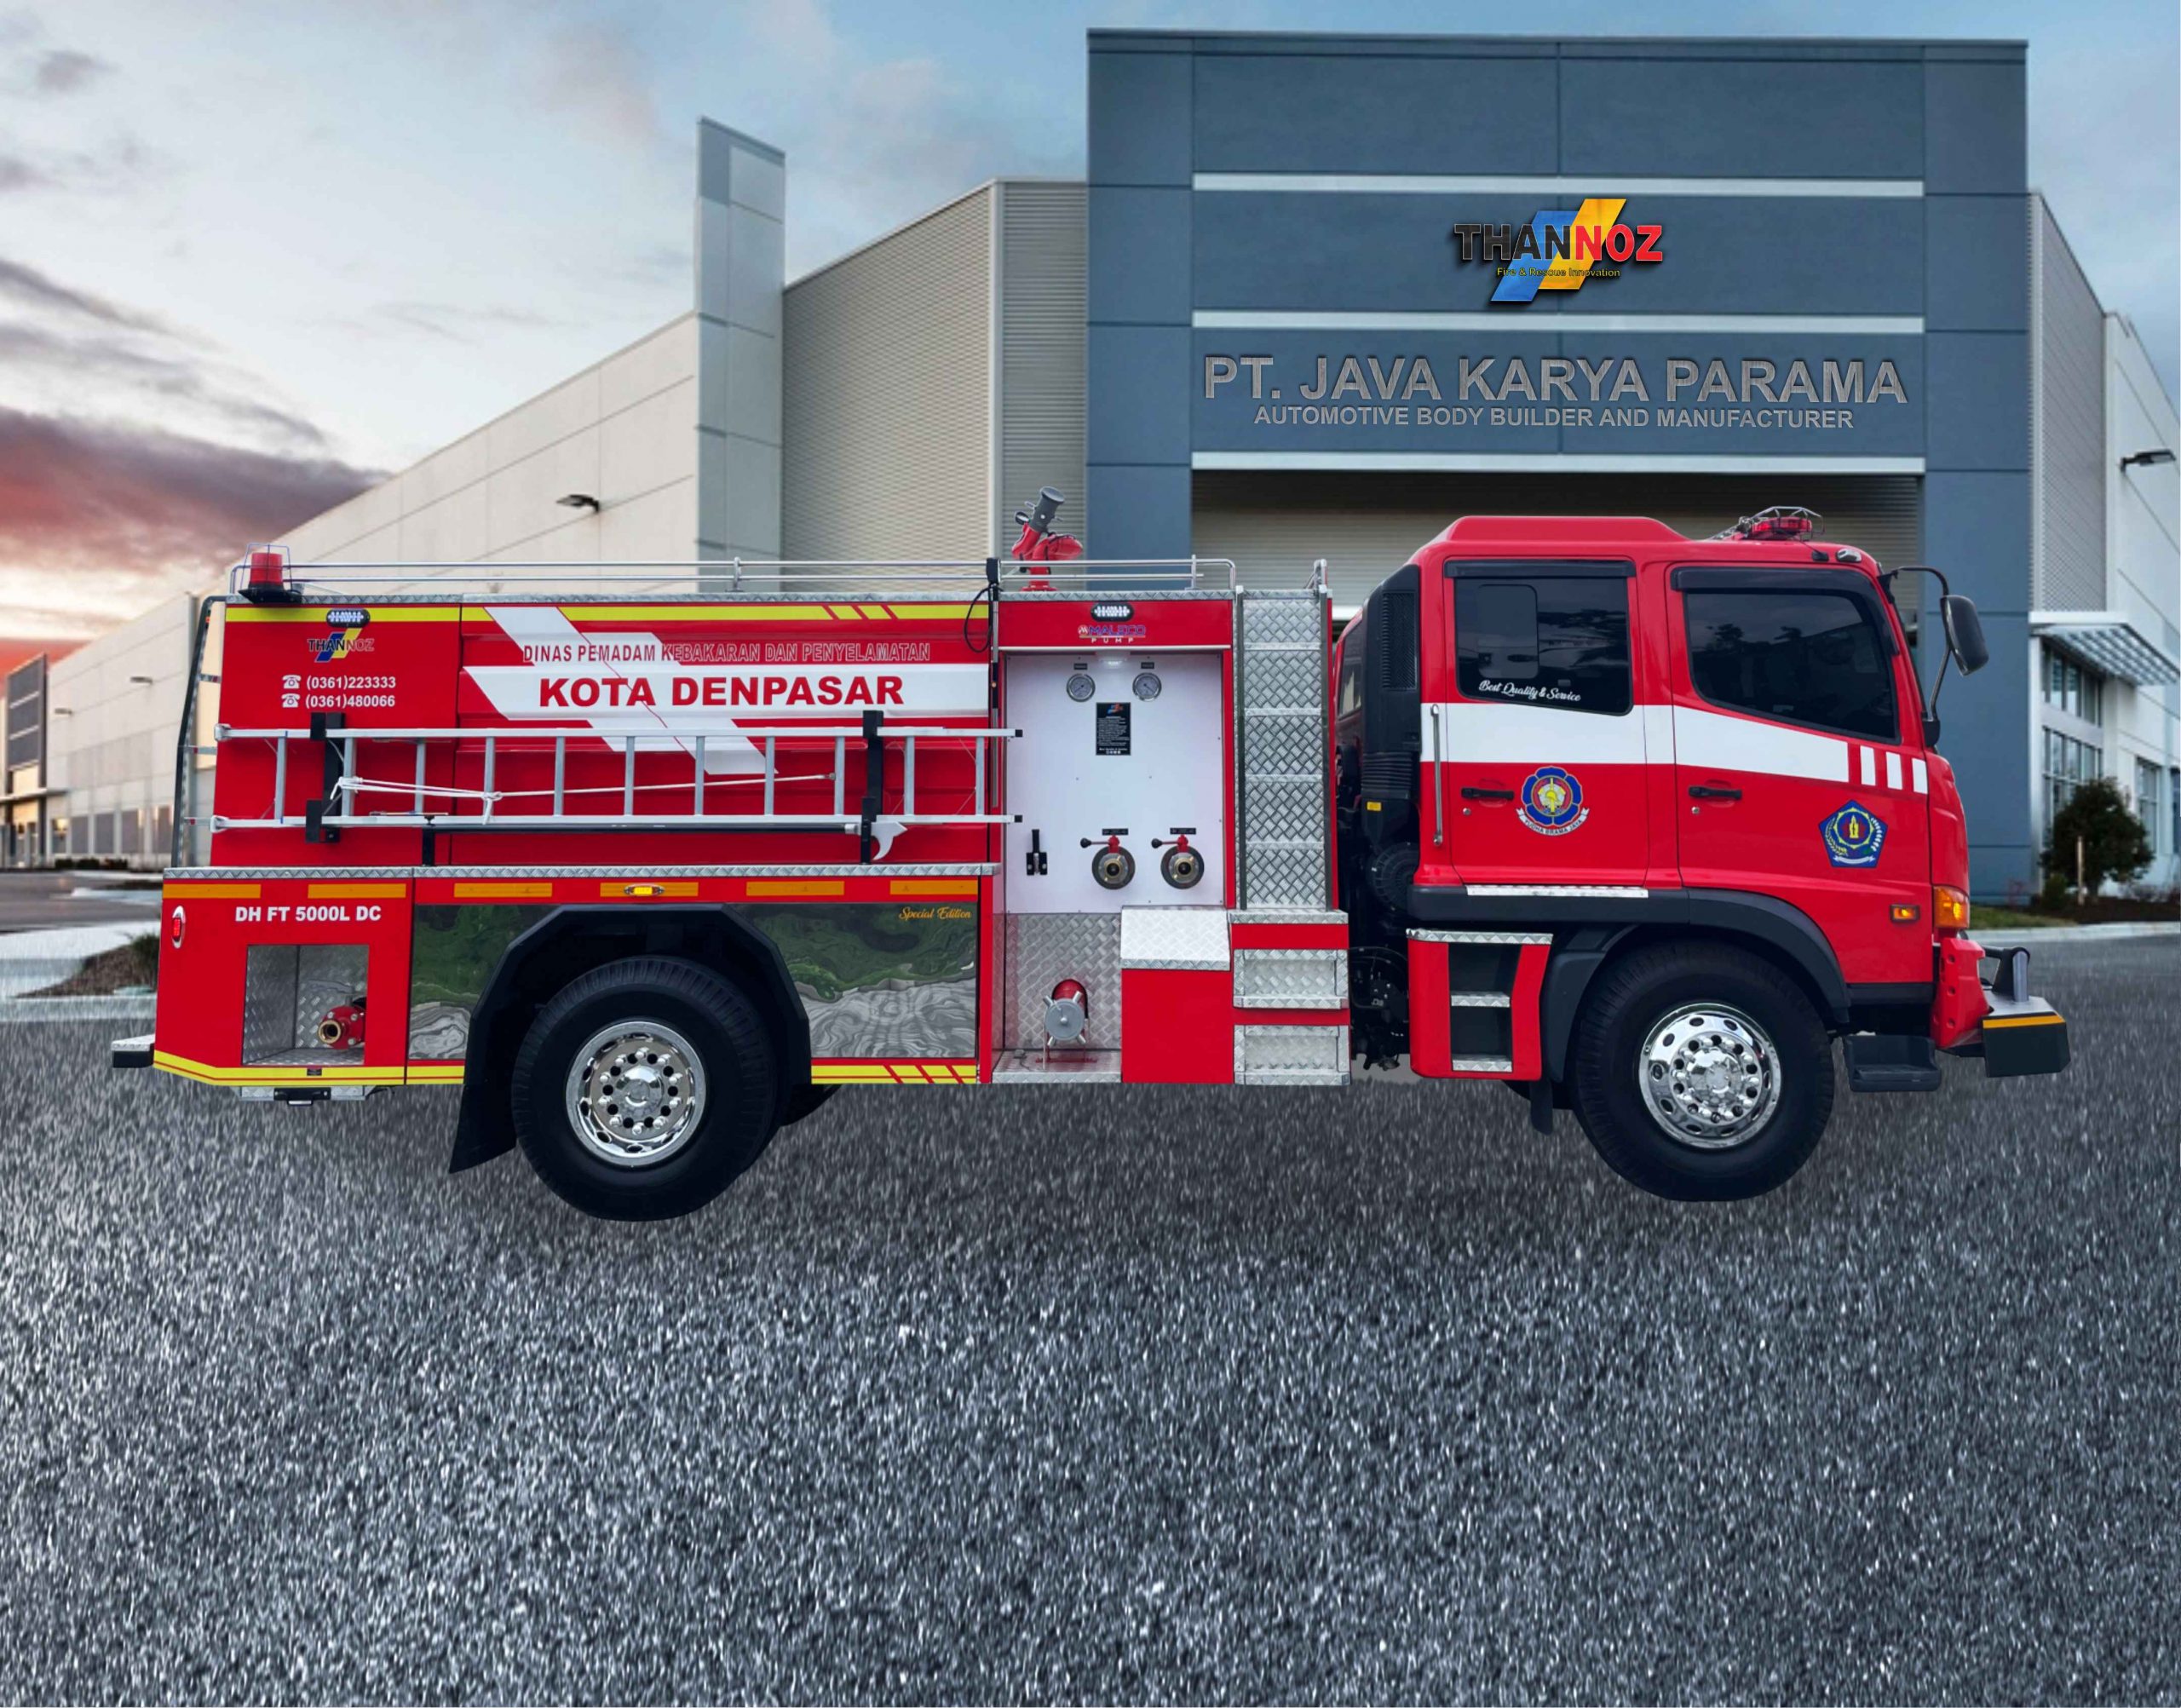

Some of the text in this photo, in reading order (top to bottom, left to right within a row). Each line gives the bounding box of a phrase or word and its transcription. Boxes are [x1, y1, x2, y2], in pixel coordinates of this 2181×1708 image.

[1453, 223, 1663, 262] THANNOZ
[1497, 267, 1620, 278] Fire & Rescue Innovation
[1204, 355, 1908, 404] PT. JAVA KARYA PARAMA
[1253, 405, 1854, 428] AUTOMOTIVE BODY BUILDER AND MANUFACTURER
[307, 638, 374, 653] THANNOZ
[523, 642, 930, 663] DINAS PEMADAM KEBAKARAN DAN PENYELAMATAN
[306, 676, 396, 691] (0361)223333
[539, 676, 905, 707] KOTA DENPASAR
[1478, 680, 1581, 701] Best Quality & Service
[305, 694, 395, 709] (0361)480066
[235, 906, 382, 922] DH FT 5000L DC
[899, 906, 971, 921] Special Edition
